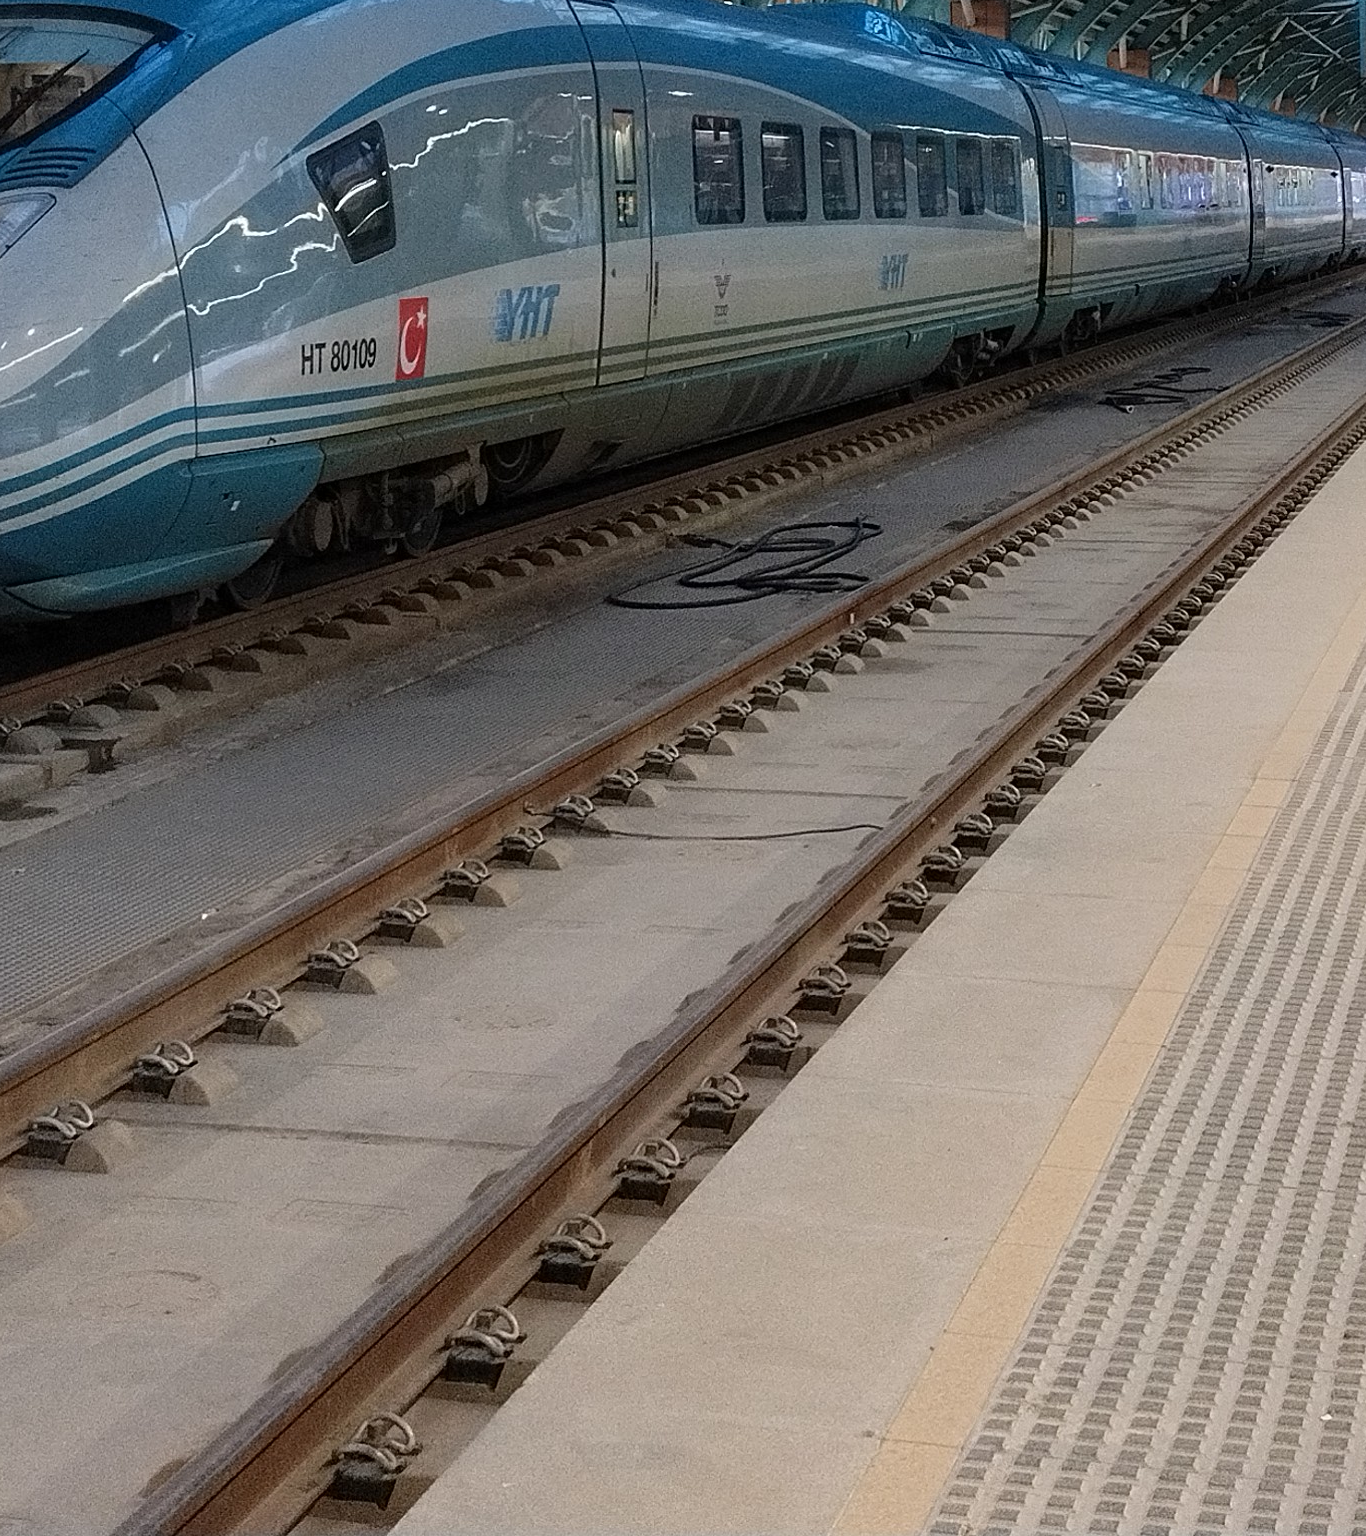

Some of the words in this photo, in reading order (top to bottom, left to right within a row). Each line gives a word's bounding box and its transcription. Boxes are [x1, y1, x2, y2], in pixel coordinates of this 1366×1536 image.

[496, 284, 561, 342] YHT
[301, 343, 326, 375] HT
[331, 338, 377, 372] 80109
